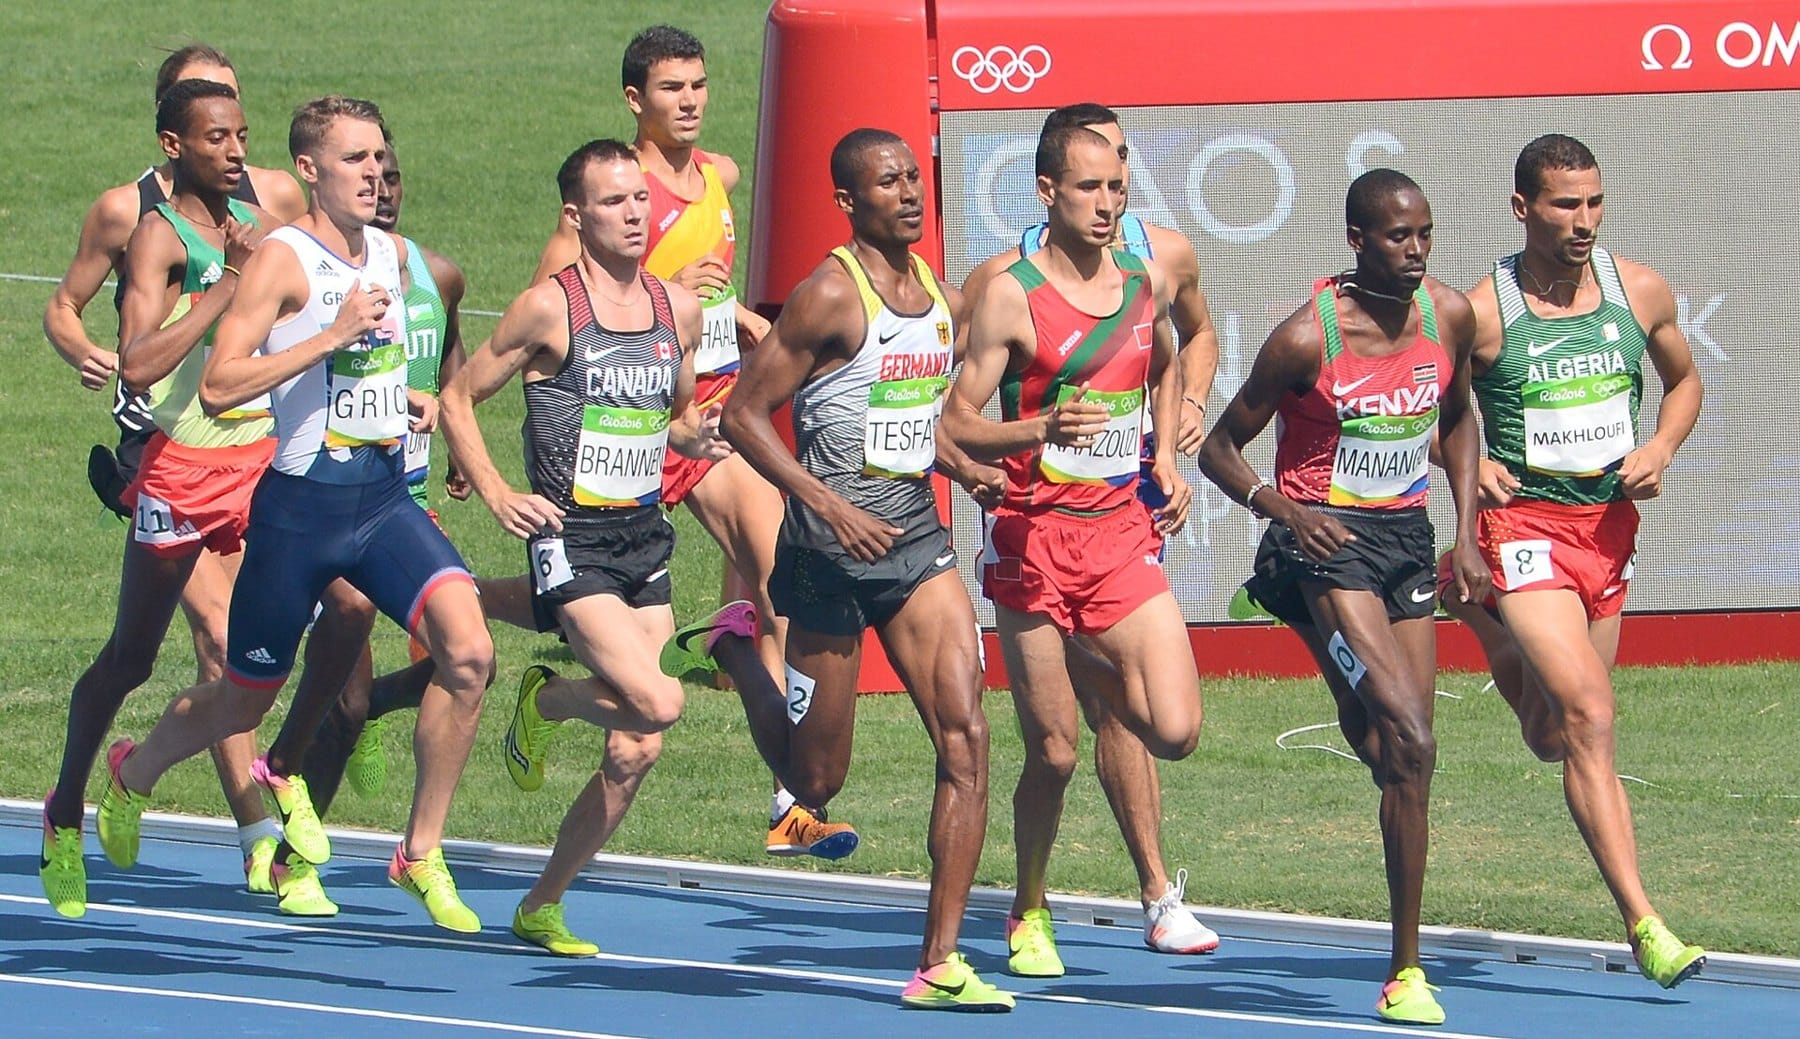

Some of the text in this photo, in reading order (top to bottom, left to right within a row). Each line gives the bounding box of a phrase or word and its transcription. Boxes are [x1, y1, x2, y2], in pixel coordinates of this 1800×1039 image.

[1716, 21, 1800, 69] OM
[880, 352, 950, 381] GERMANY
[1527, 349, 1627, 384] ALGERIA
[586, 365, 672, 398] CANADA
[884, 387, 921, 402] Rio2016
[1540, 387, 1586, 402] Rio2016
[1336, 383, 1439, 420] KENYA
[599, 414, 643, 429] Rio2016
[1359, 421, 1405, 434] Rio2016
[1533, 421, 1625, 446] MAKHLOUFI
[580, 444, 666, 477] BRANNEN
[137, 505, 170, 535] 11
[538, 548, 553, 578] 6
[1515, 549, 1534, 575] 8
